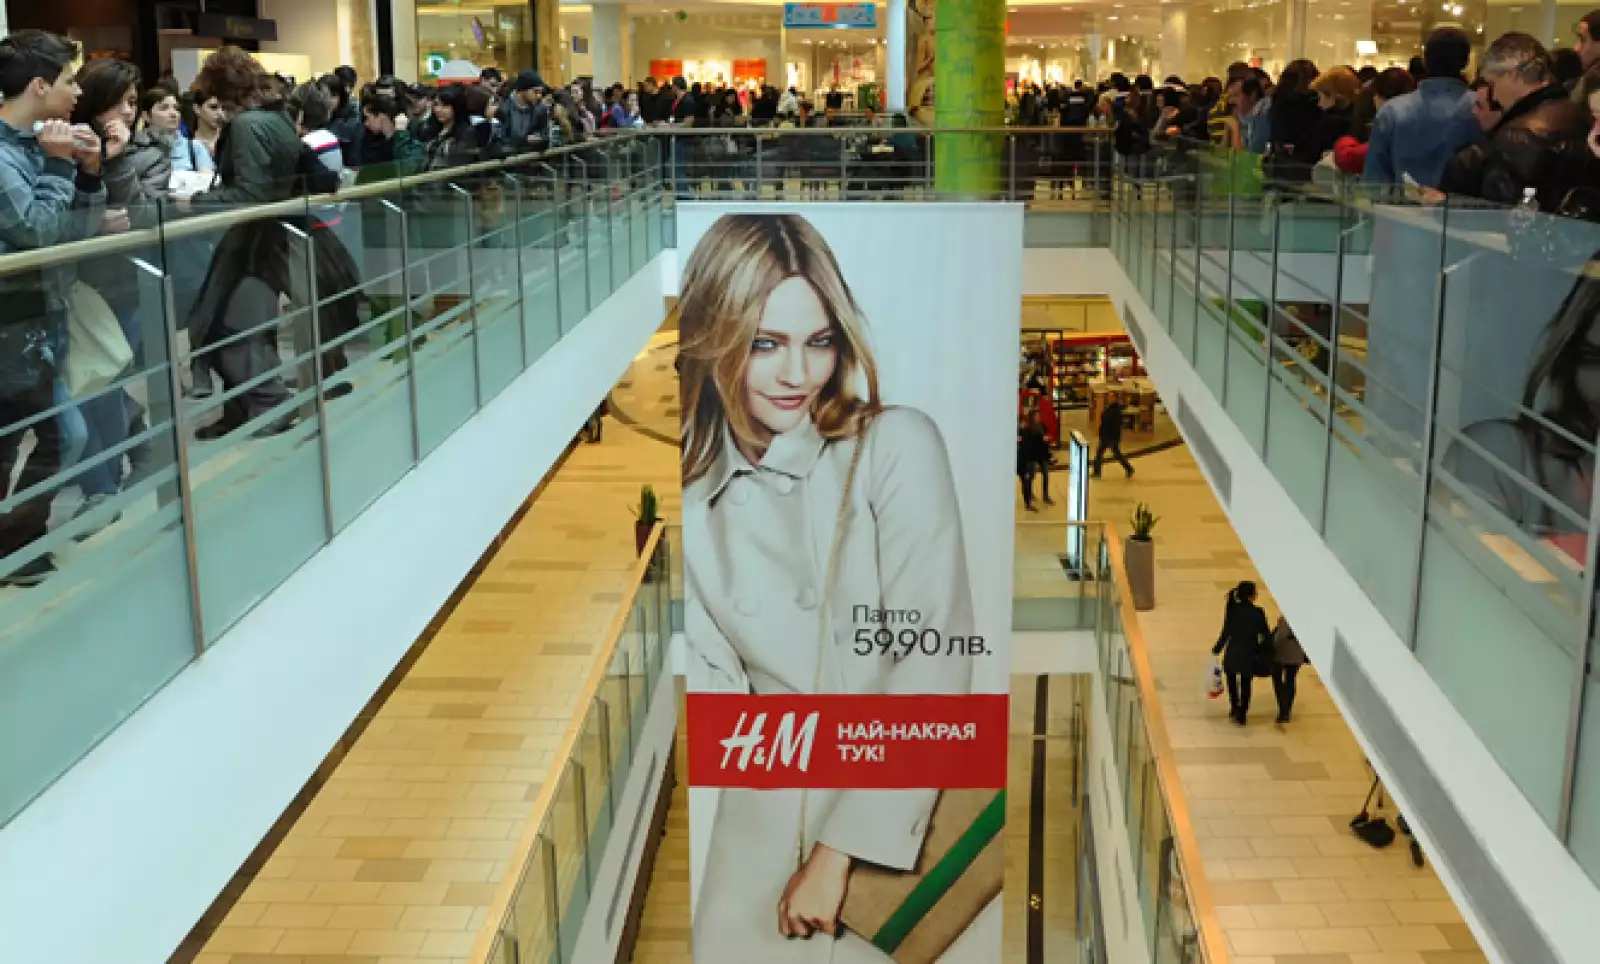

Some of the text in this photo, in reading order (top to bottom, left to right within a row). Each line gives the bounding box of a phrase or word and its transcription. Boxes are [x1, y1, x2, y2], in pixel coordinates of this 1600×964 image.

[853, 628, 992, 665] 59,90 лв.
[720, 711, 820, 772] H&M
[836, 720, 978, 742] НАЙ-НАКРАЯ
[837, 744, 886, 763] ТУК!
